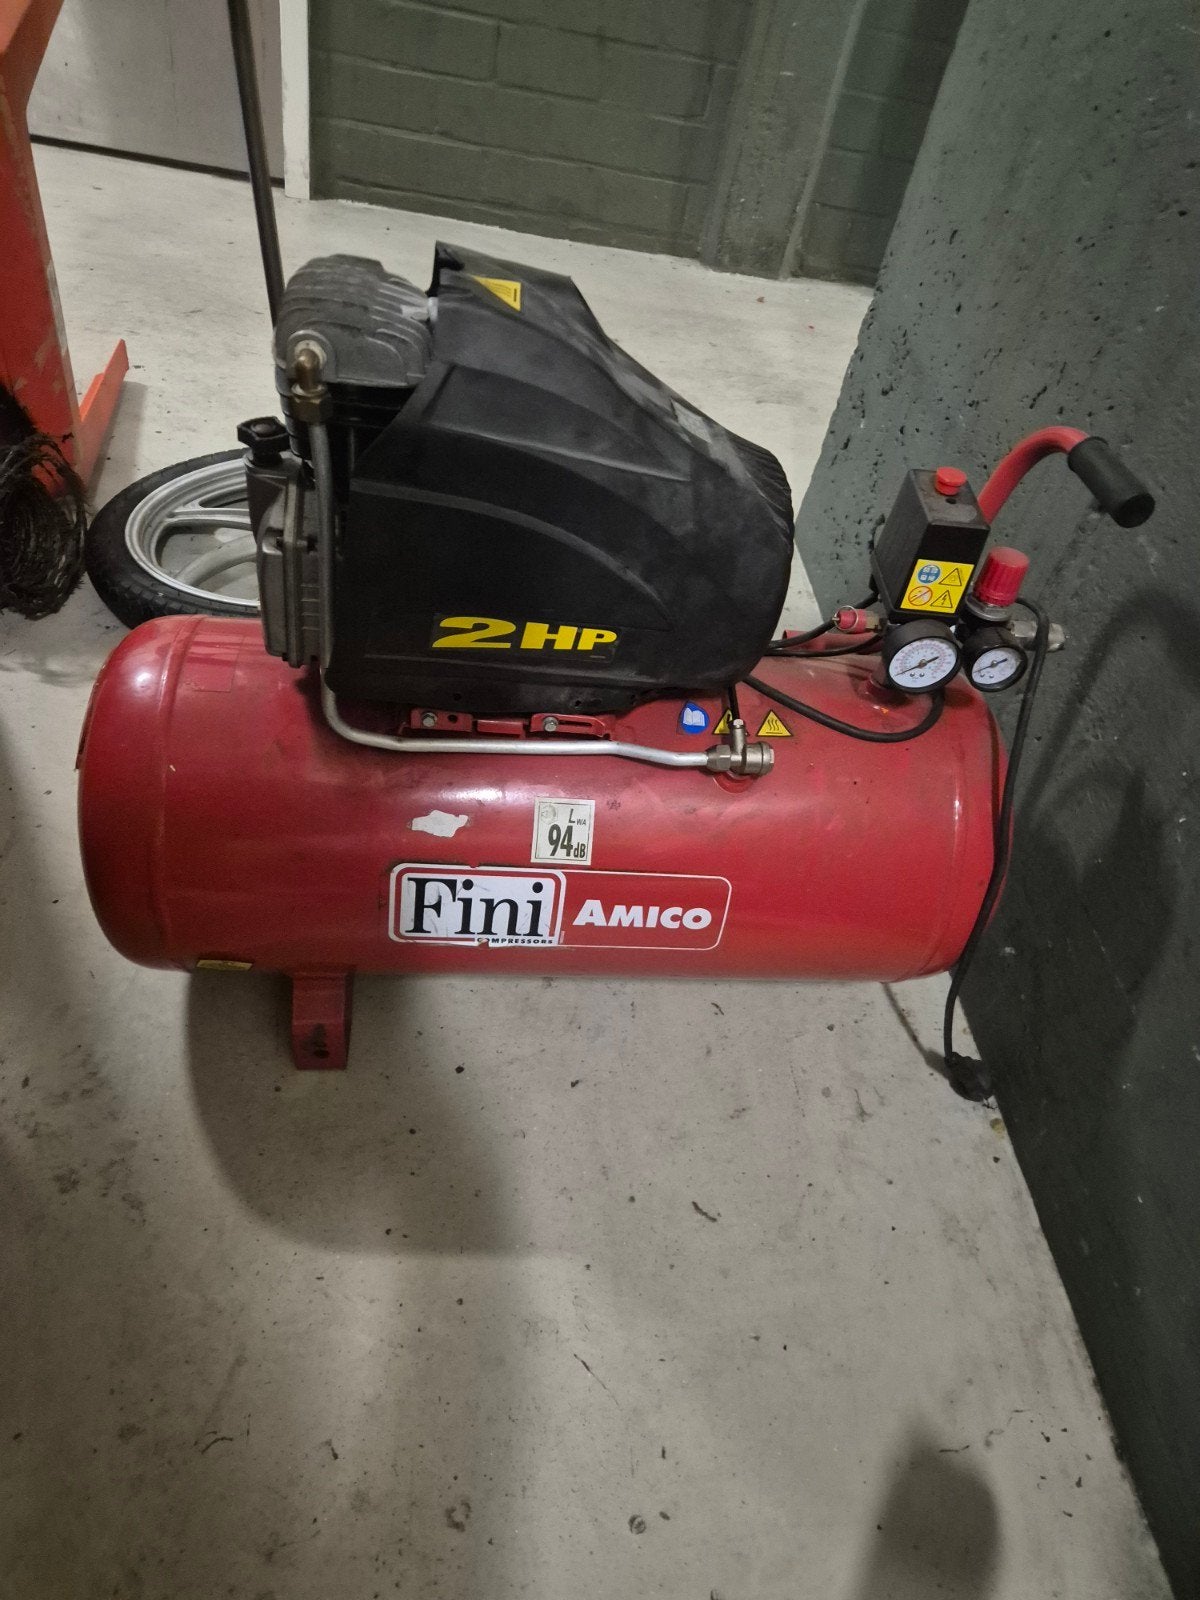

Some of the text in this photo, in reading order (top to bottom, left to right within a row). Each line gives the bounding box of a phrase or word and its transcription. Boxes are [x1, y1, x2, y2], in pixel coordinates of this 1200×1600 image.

[432, 616, 618, 650] 2 HP
[405, 877, 544, 937] Fini
[572, 899, 712, 930] AMICO
